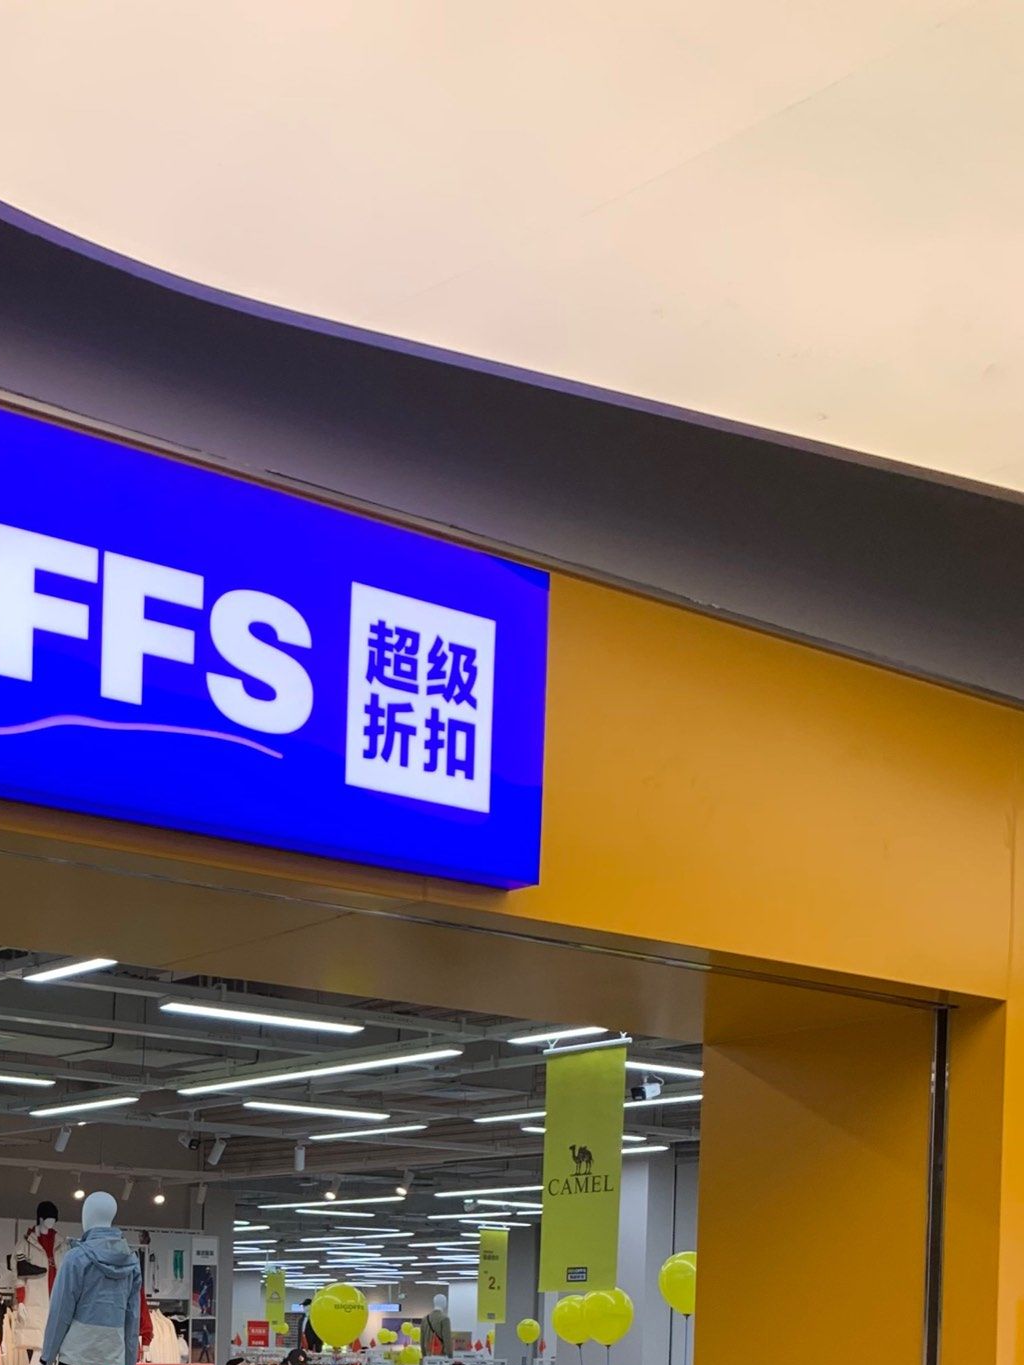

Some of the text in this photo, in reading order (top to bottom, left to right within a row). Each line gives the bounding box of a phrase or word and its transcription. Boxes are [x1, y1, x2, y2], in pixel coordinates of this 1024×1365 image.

[364, 618, 479, 711] 超级
[362, 692, 477, 782] 折扣
[548, 1174, 614, 1196] CAMEL
